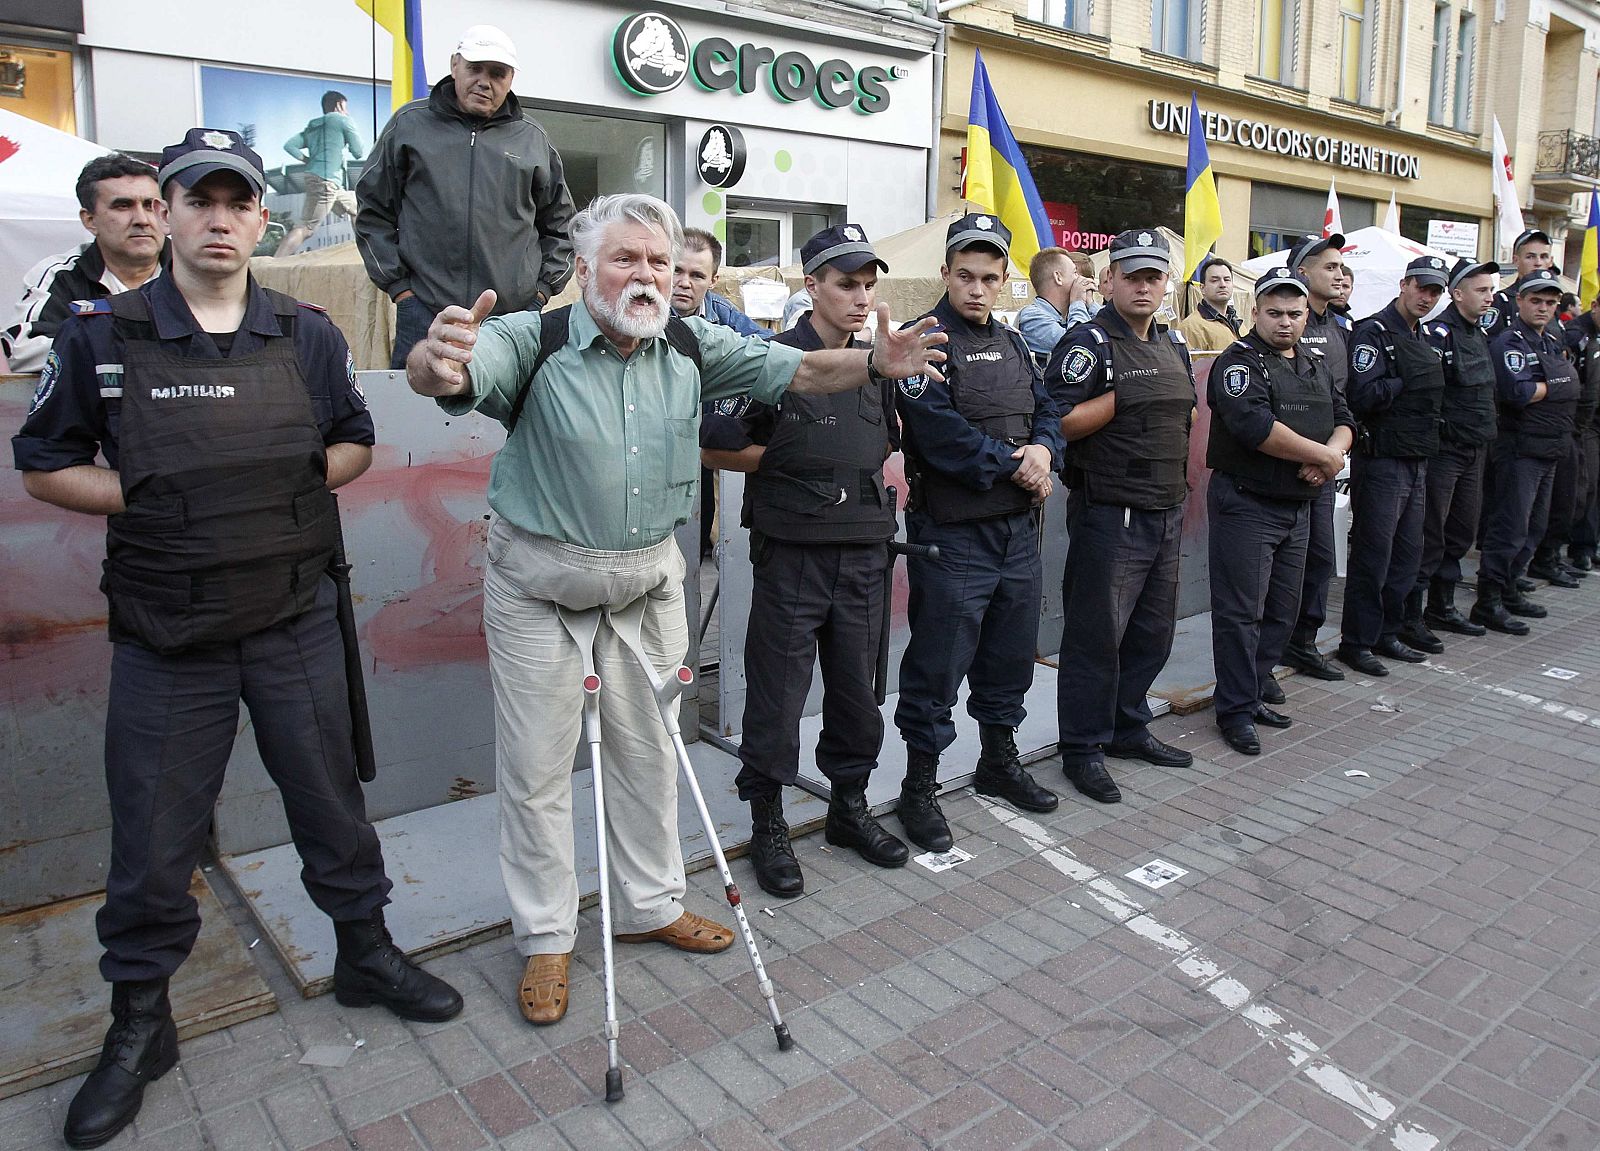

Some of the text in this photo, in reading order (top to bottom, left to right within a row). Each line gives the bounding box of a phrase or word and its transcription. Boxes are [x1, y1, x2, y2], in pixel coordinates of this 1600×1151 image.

[692, 37, 891, 114] crocs
[1237, 119, 1312, 158] COLORS
[1314, 135, 1339, 163] OF
